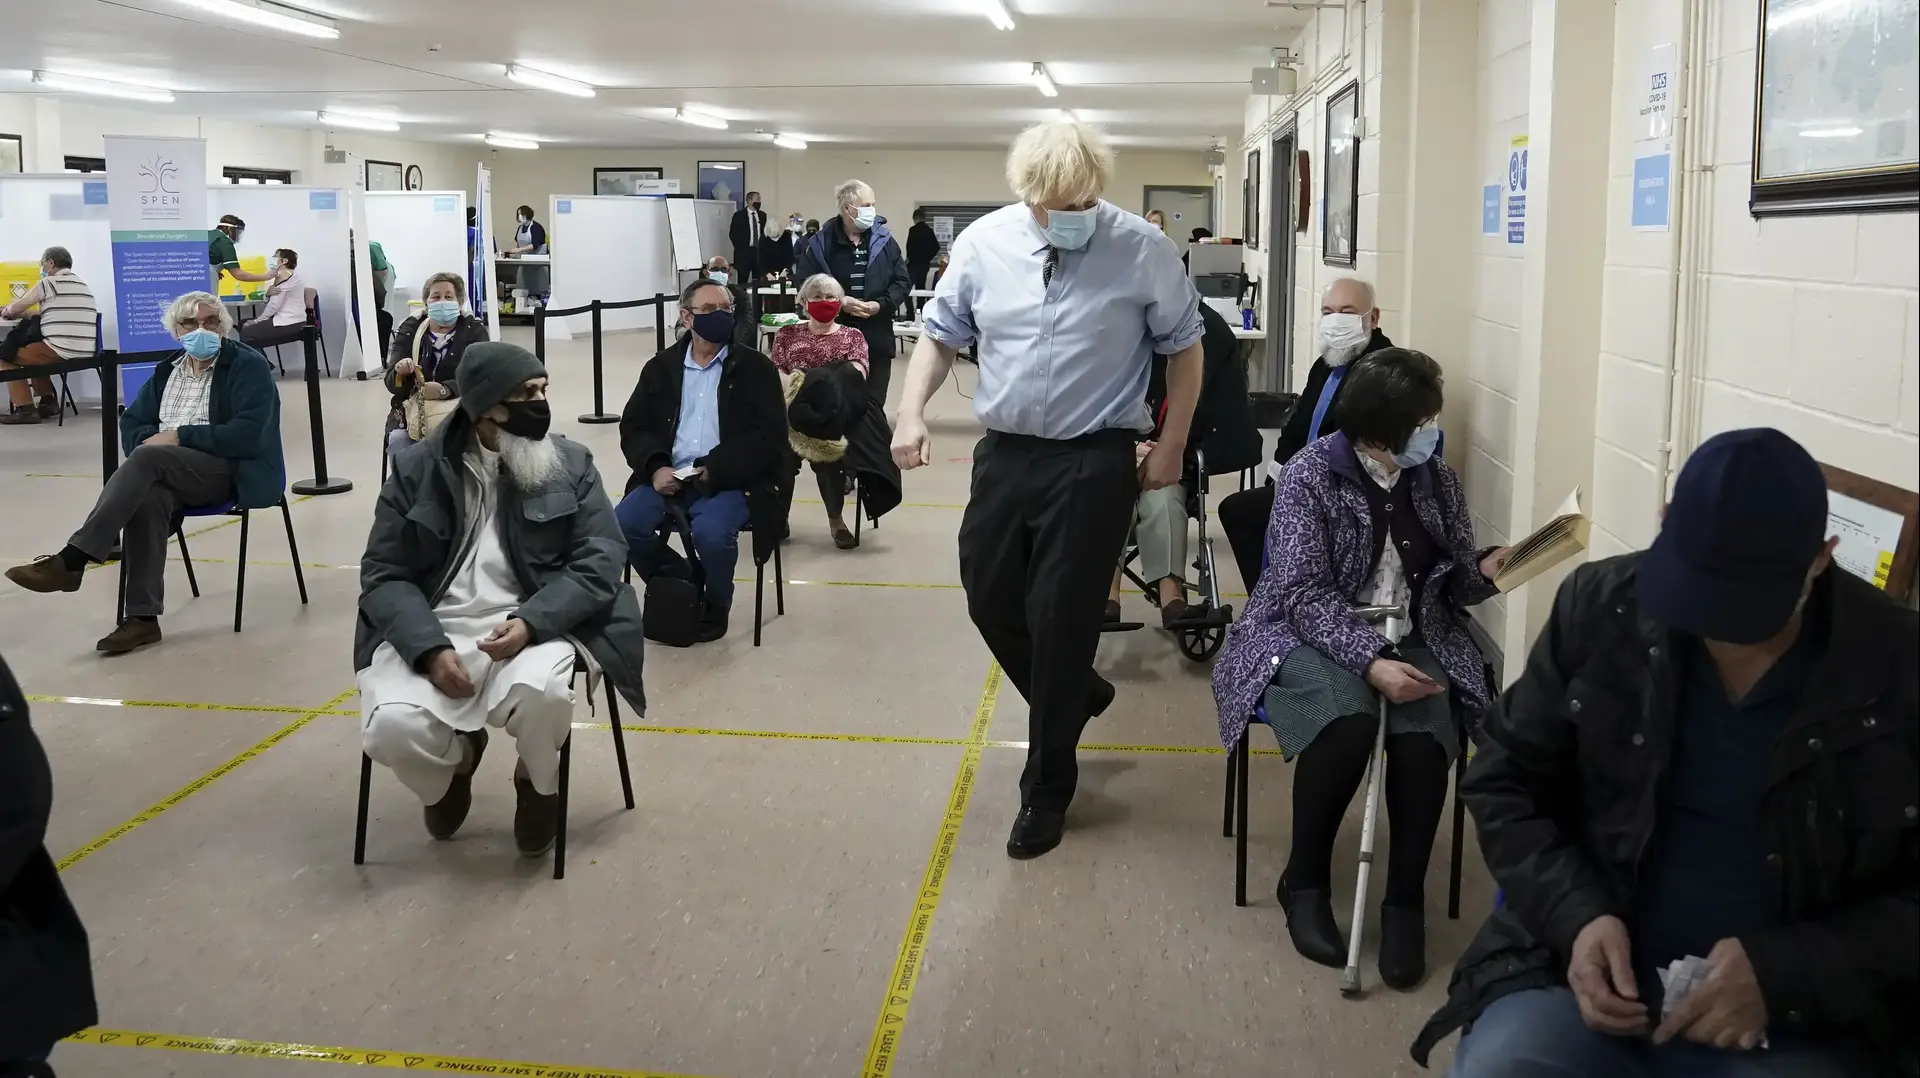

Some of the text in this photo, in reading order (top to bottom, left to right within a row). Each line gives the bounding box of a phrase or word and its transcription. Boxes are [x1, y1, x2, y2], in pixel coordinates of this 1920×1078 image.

[1652, 73, 1666, 90] NHS
[141, 195, 180, 205] SPEN
[929, 867, 944, 888] DISTANCE
[915, 914, 929, 932] PLEASE
[912, 931, 924, 945] KEEP
[907, 949, 919, 964] SAFE
[897, 961, 915, 992] DISTANCE
[164, 1039, 225, 1051] DISTANCE
[879, 1028, 896, 1055] PLEASE
[434, 1060, 497, 1072] DISTANCE
[499, 1065, 530, 1075] SAFE
[874, 1054, 889, 1072] KEEP
[547, 1070, 580, 1078] KEEP
